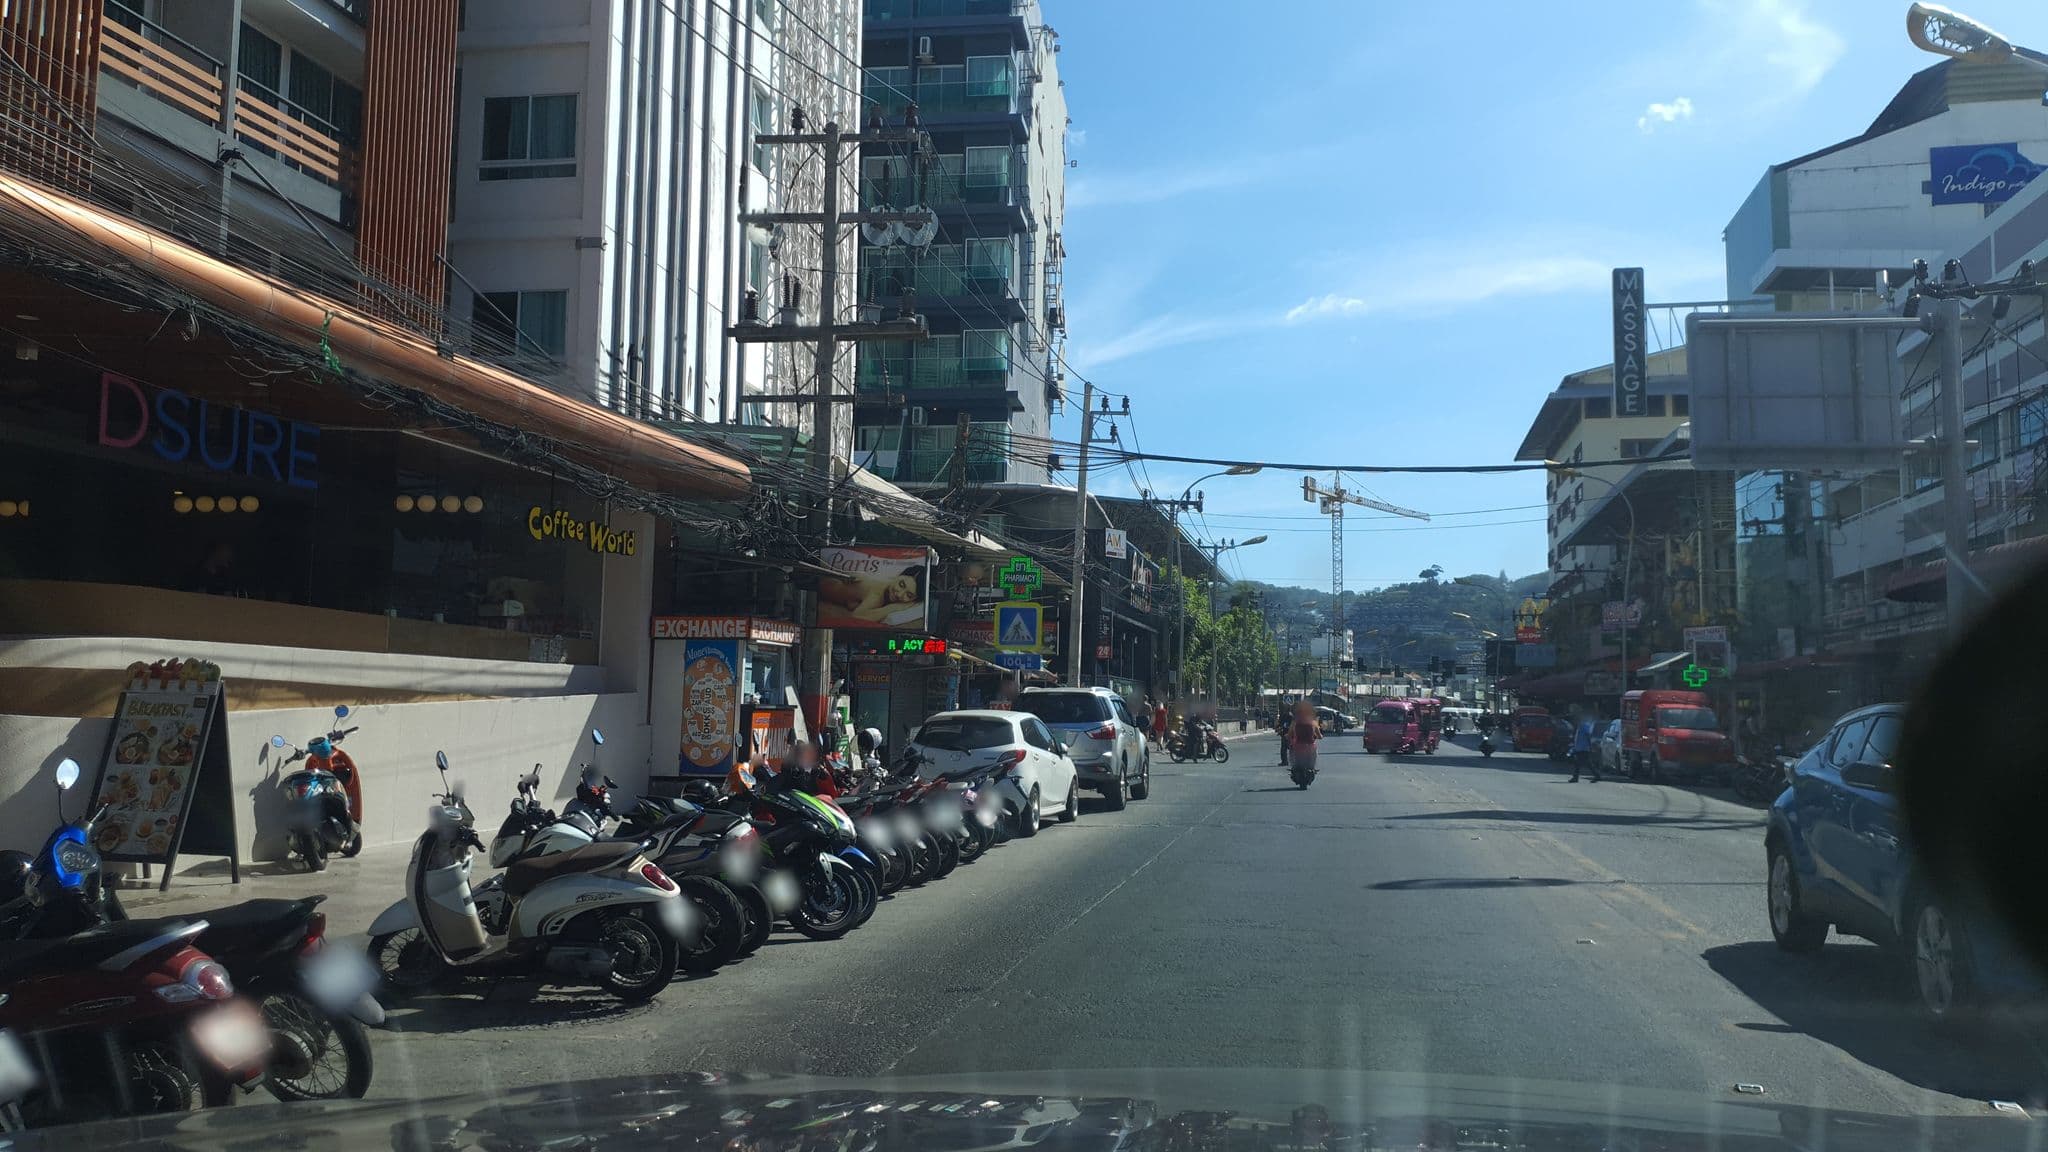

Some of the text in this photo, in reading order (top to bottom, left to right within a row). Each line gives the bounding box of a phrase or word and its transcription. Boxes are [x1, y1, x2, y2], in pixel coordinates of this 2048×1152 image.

[1942, 173, 2006, 197] Indigo
[1619, 271, 1640, 412] MASSAGE
[99, 371, 321, 490] DSURE
[528, 506, 636, 556] Coffee World
[829, 549, 880, 573] Paris
[1004, 573, 1037, 583] PHARMACY
[654, 619, 747, 638] EXCHANGE
[751, 620, 801, 644] EXCHANGE
[1003, 656, 1022, 667] 100
